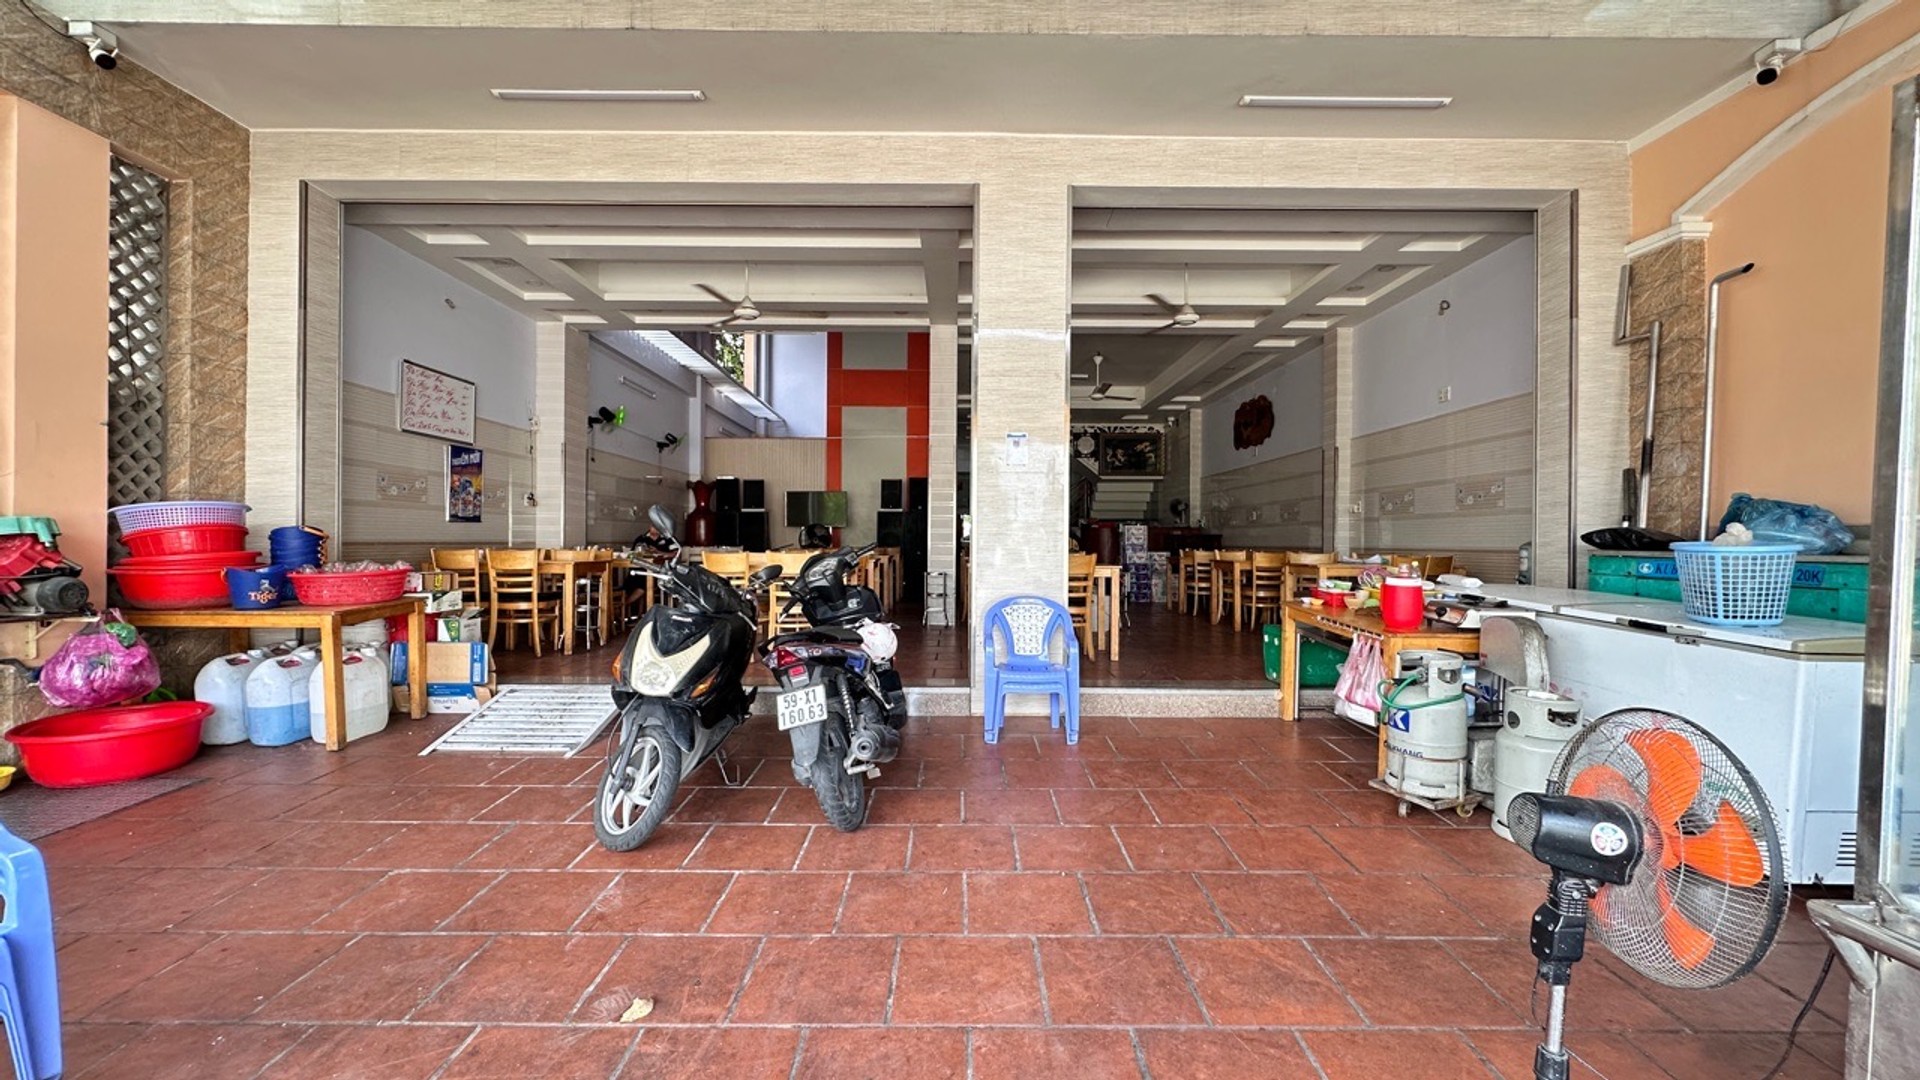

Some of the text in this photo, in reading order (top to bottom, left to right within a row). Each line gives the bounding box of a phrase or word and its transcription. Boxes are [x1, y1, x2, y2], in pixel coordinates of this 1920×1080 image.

[1796, 567, 1821, 583] 20K
[248, 591, 278, 604] Tiger
[783, 689, 817, 709] 59-X1
[780, 704, 824, 726] 160.63
